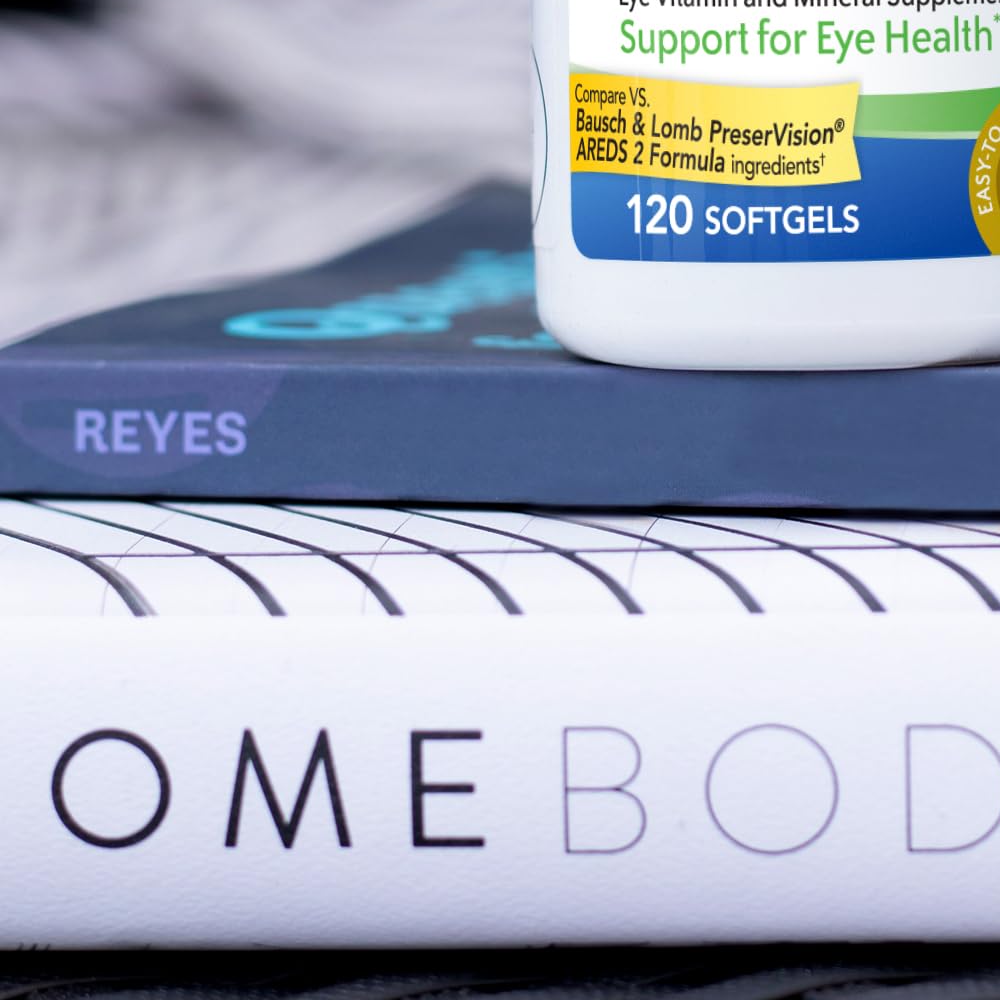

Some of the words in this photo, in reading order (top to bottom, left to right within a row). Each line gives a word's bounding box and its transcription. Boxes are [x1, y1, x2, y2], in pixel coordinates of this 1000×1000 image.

[620, 19, 749, 64] Support
[757, 17, 807, 55] for
[817, 21, 875, 62] Eye
[574, 83, 626, 110] Compare
[629, 87, 650, 107] VS.
[576, 108, 627, 134] Bausch
[632, 111, 645, 135] &
[652, 114, 703, 142] Lomb
[576, 137, 628, 163] AREDS
[633, 141, 644, 165] 2
[650, 143, 725, 172] Formula
[626, 194, 693, 235] 120
[705, 204, 860, 236] SOFTGELS
[74, 409, 247, 455] REYES
